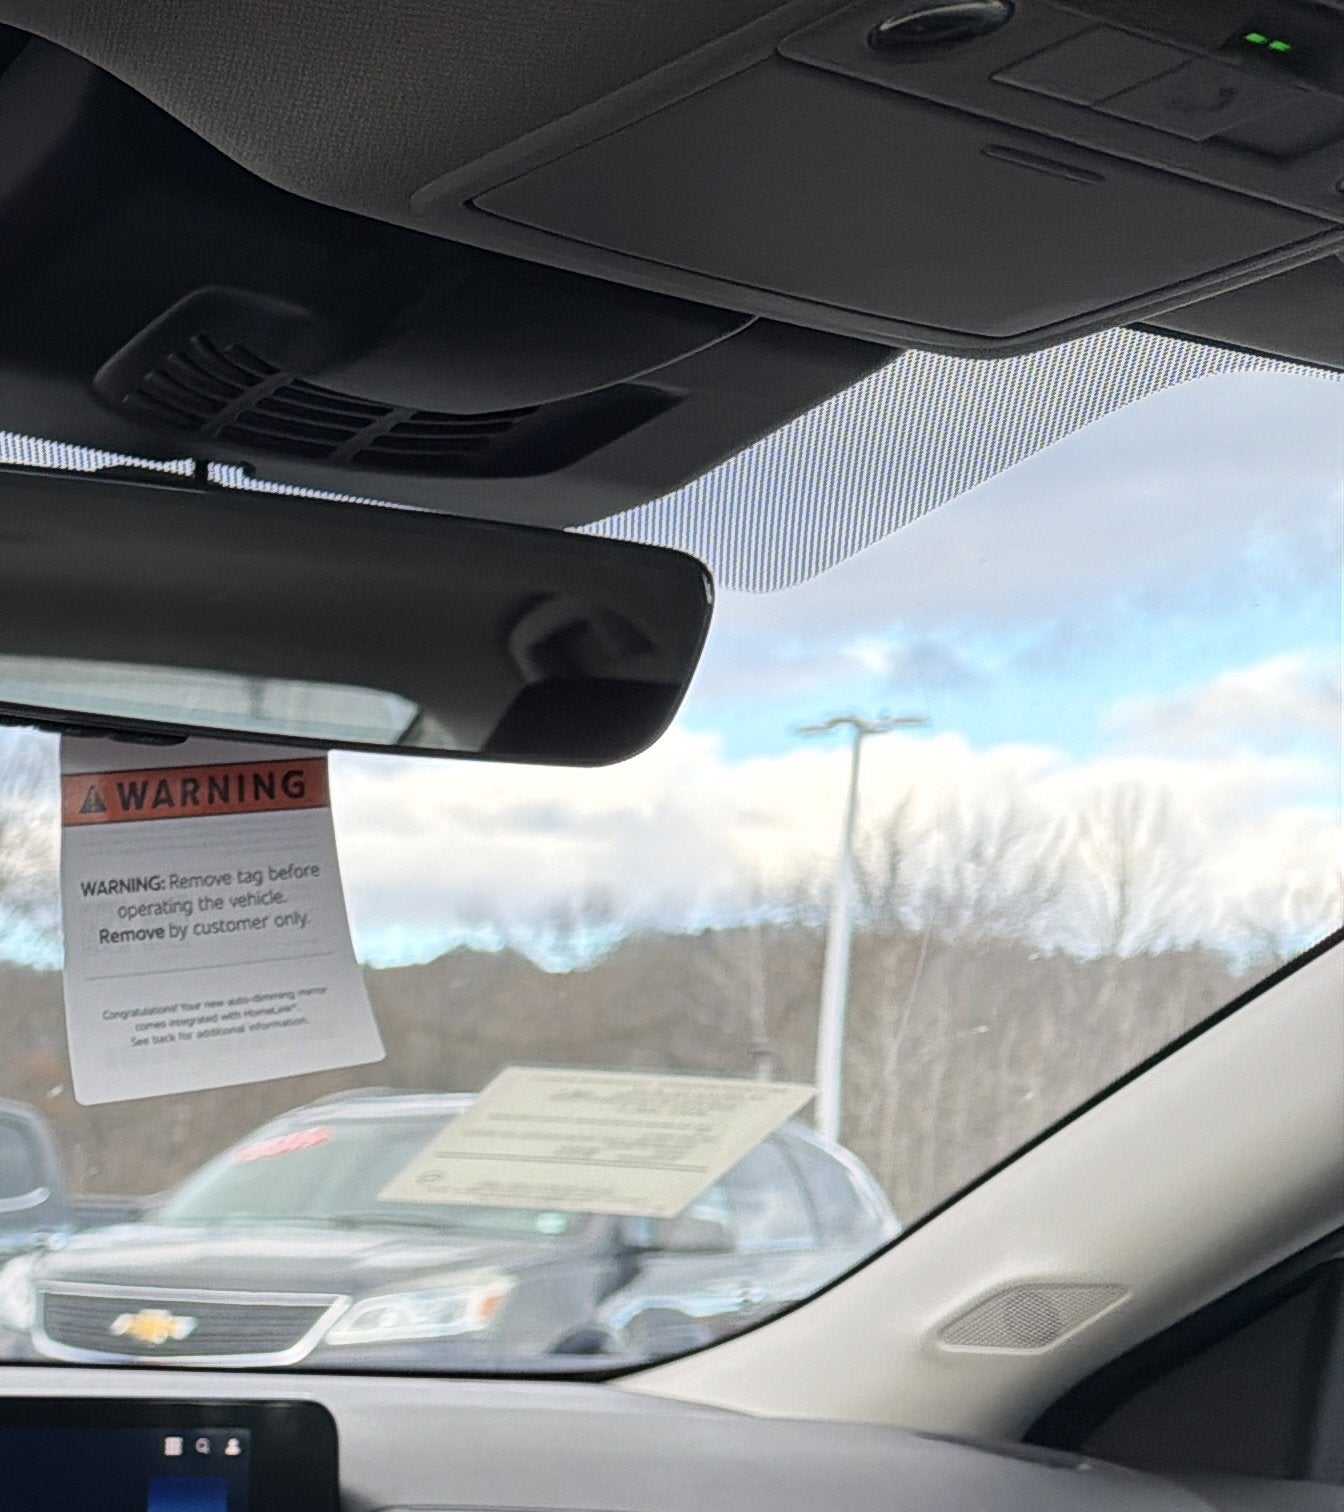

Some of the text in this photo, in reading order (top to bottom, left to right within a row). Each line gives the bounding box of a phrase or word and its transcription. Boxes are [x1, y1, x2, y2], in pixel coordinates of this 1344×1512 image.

[116, 770, 306, 812] WARNING
[80, 863, 321, 897] WARNING: Remove tag before
[117, 889, 287, 921] operating the vehicle.
[99, 911, 311, 944] Remove by customer only.
[102, 1004, 178, 1020] Congratulations!
[180, 1001, 202, 1012] Your
[169, 1013, 219, 1028] integrated
[221, 1010, 242, 1021] with
[130, 1036, 149, 1047] See
[153, 1033, 176, 1045] back
[179, 1030, 193, 1041] for
[196, 1024, 246, 1039] additional
